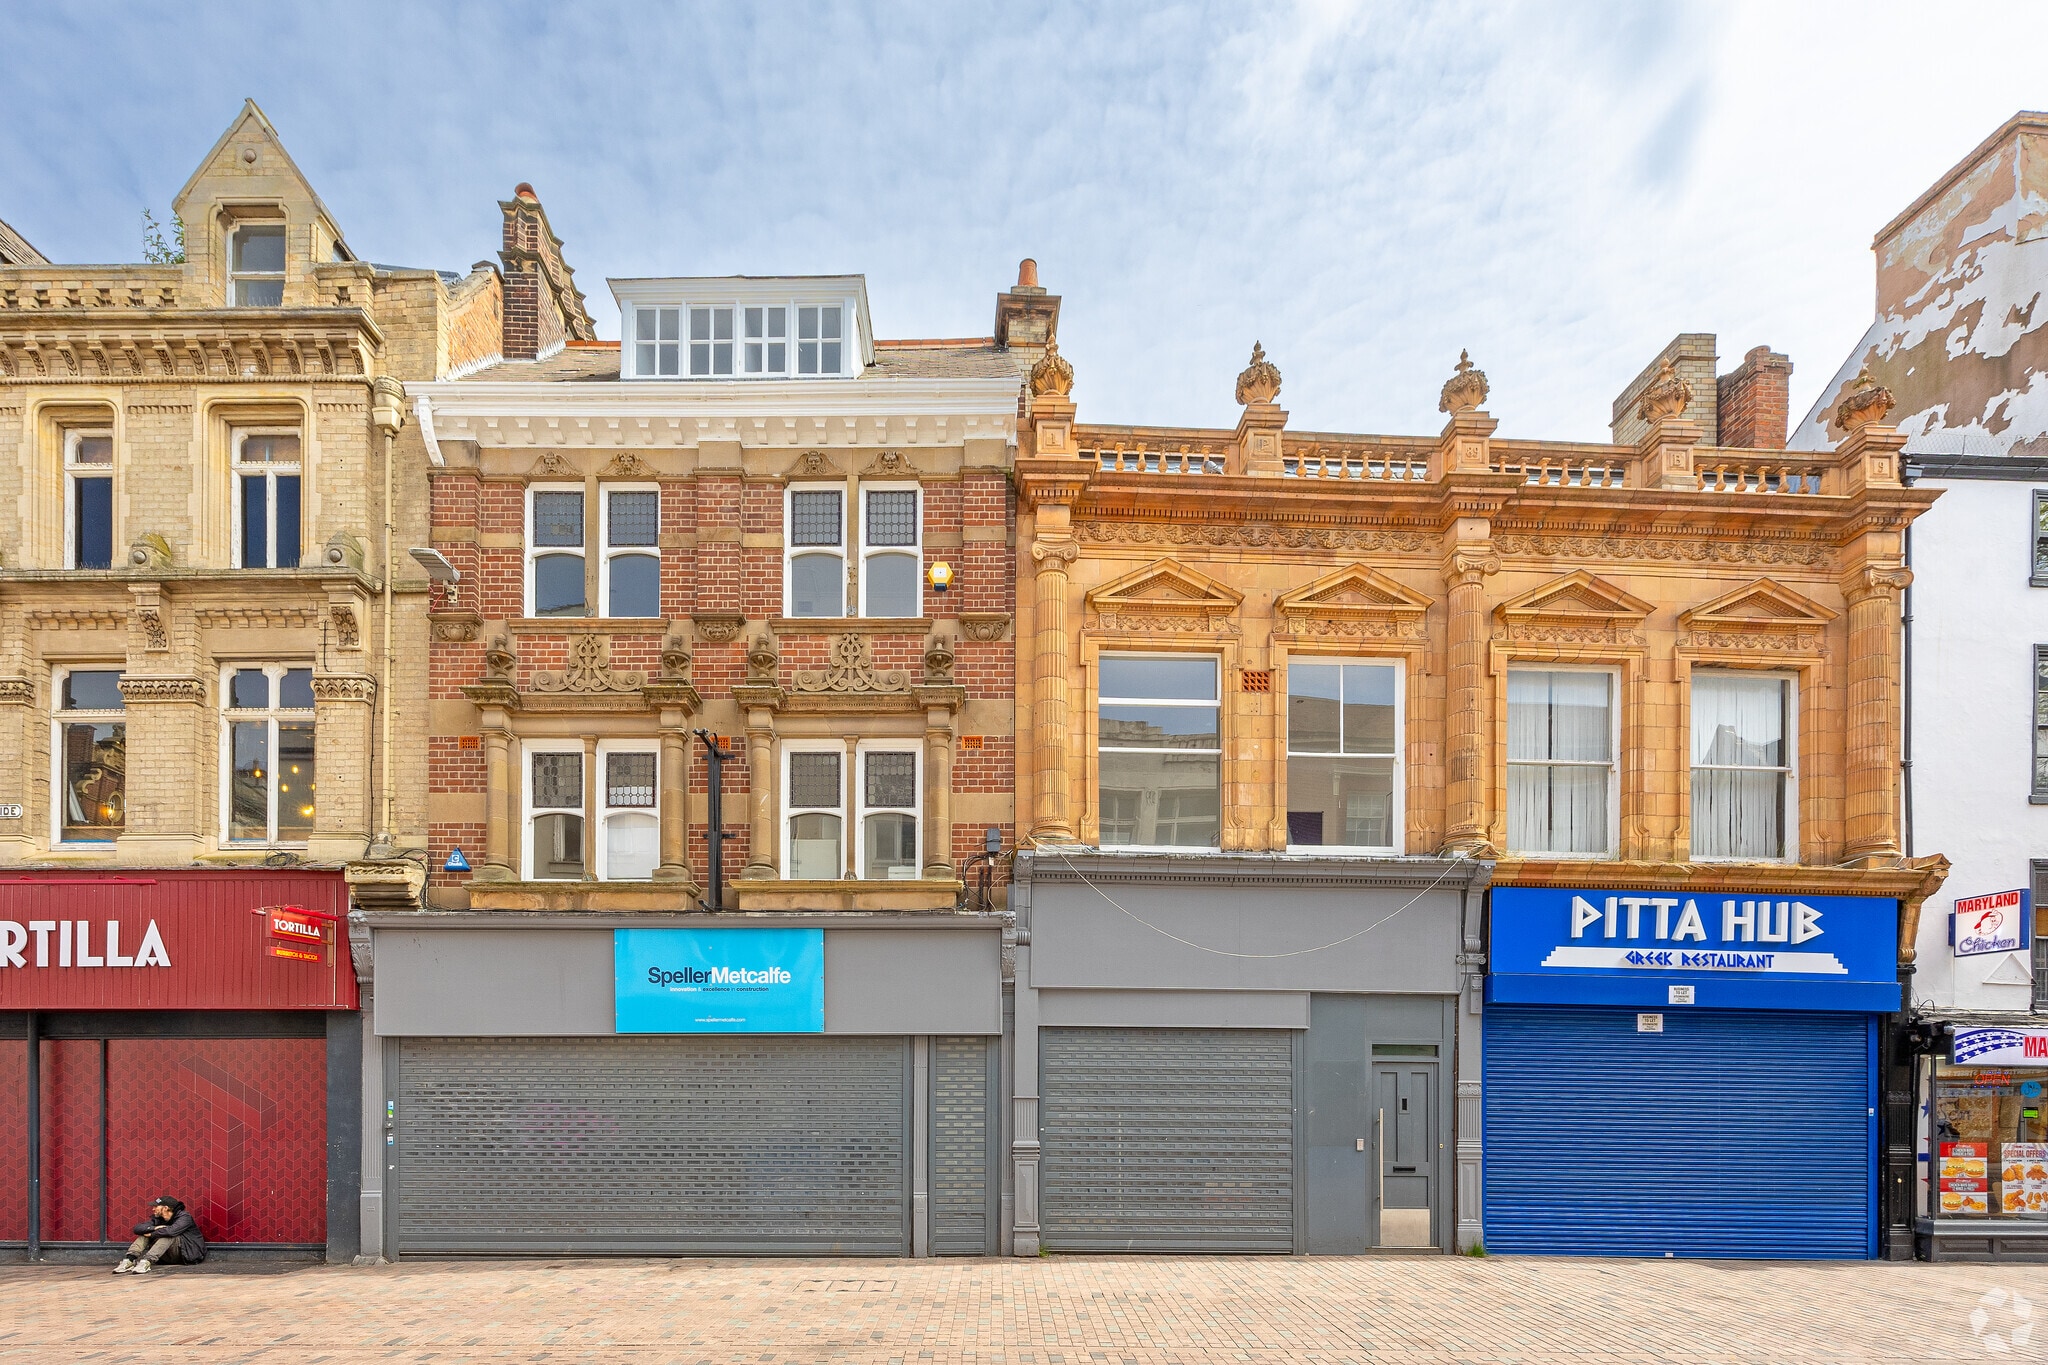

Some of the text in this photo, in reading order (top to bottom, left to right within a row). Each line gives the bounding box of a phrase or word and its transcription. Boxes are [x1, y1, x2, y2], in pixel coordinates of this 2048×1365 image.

[1957, 892, 2019, 914] MARYLAND
[273, 918, 320, 937] TORTILLA
[1571, 895, 1825, 945] PITTA HUB
[0, 919, 172, 968] RTILLA
[1959, 935, 2016, 953] Chicken
[1625, 950, 1775, 968] GREEK RESTAURANT
[2024, 1036, 2048, 1057] MA
[1974, 1073, 2011, 1086] OPEN
[2003, 1149, 2047, 1159] SPECIAL OFFERS
